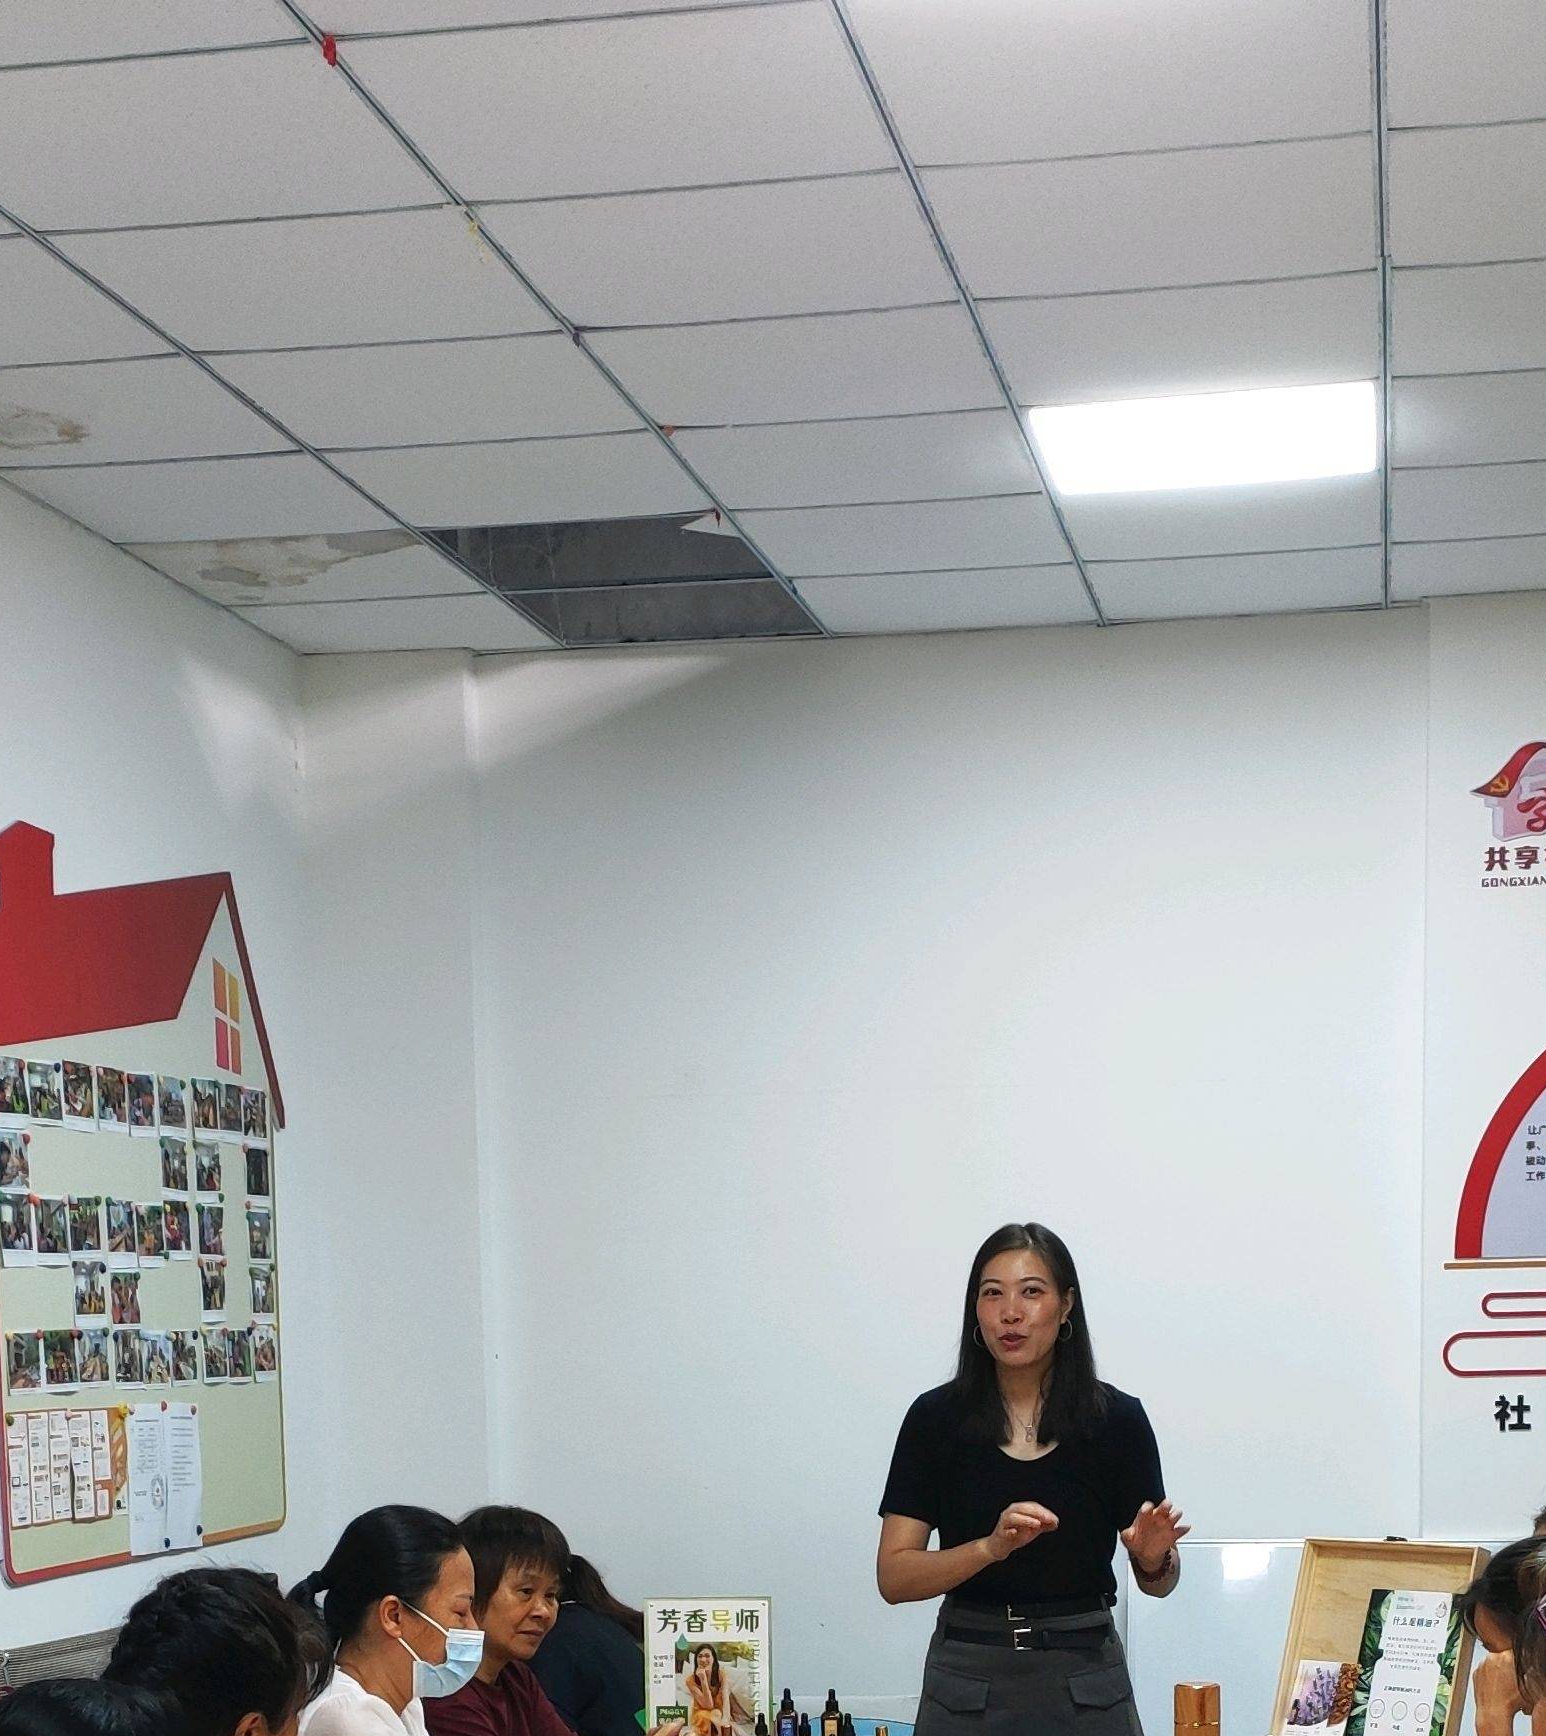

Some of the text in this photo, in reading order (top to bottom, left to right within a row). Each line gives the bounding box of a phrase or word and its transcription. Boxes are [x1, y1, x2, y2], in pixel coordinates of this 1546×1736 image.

[1525, 1170, 1546, 1182] 工作
[656, 1608, 760, 1634] 芳香导师
